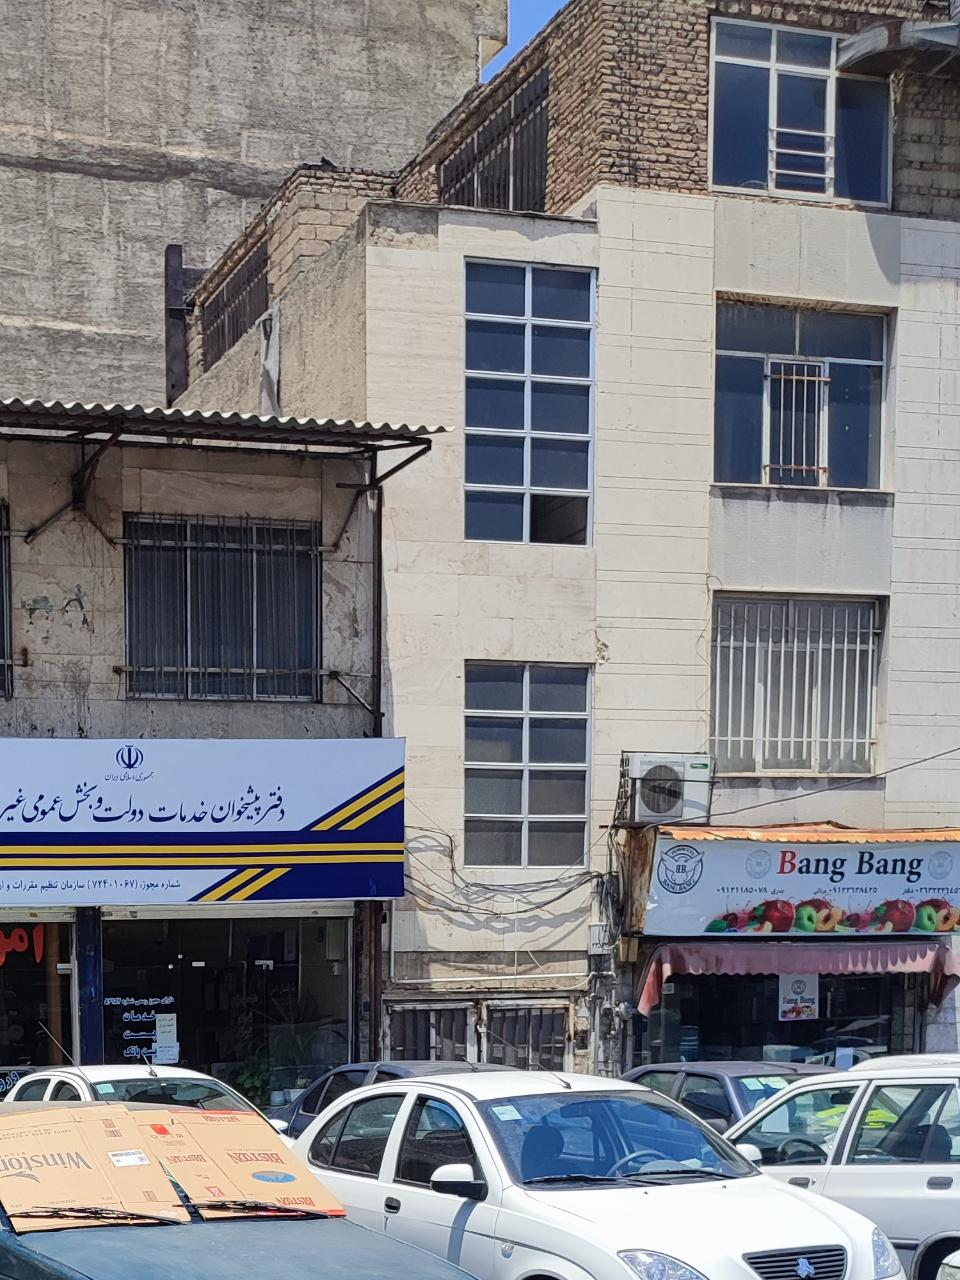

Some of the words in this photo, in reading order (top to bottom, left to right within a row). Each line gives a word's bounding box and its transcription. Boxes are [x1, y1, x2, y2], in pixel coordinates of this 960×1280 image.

[21, 793, 63, 824] عمومی
[58, 781, 98, 823] بخش
[92, 793, 144, 823] دولت
[94, 795, 103, 810] و
[149, 800, 208, 824] خدمات
[211, 784, 261, 824] پیشخوان
[253, 785, 286, 826] دفتر
[776, 850, 847, 883] Bang
[855, 850, 924, 884] Bang
[12, 879, 38, 892] مقررات
[40, 879, 58, 893] تنظیم
[60, 879, 85, 891] سازمان
[160, 879, 181, 891] شماره
